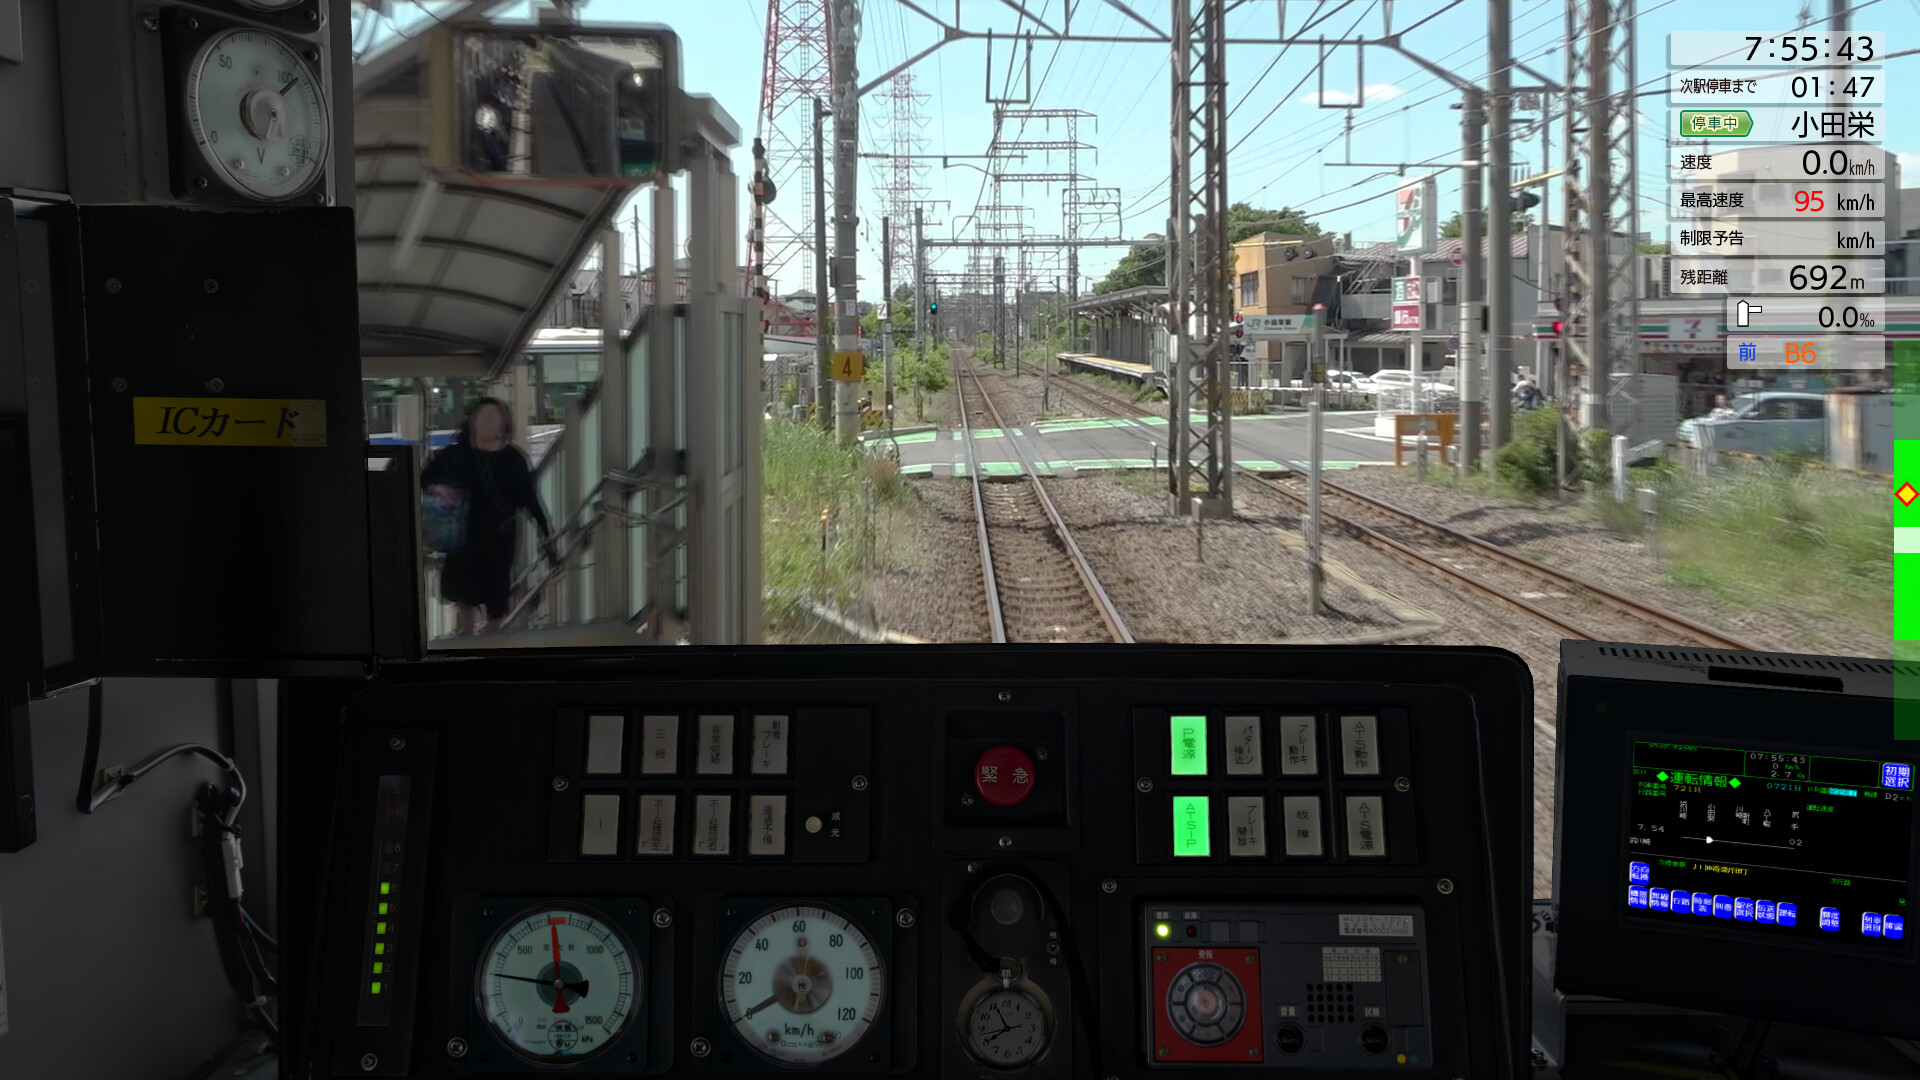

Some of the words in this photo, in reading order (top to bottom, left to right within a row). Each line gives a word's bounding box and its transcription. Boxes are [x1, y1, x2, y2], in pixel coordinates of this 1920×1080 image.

[219, 55, 232, 69] 50
[278, 70, 292, 83] 100
[211, 130, 218, 144] 0
[257, 147, 265, 164] V
[1247, 319, 1261, 327] JR
[842, 356, 852, 377] 4
[156, 406, 300, 439] ICカード
[1182, 728, 1196, 760] P電源
[1243, 725, 1254, 765] パターン
[1354, 721, 1369, 769] ATS動作
[1234, 746, 1244, 765] 接近
[1289, 745, 1299, 764] 動作
[981, 765, 1029, 784] 緊急
[1885, 765, 1911, 777] 初期
[1670, 771, 1728, 788] 運転情報
[1673, 784, 1701, 794] 721H
[1766, 782, 1802, 792] 0721H
[1296, 810, 1310, 840] 故障
[1359, 802, 1375, 850] ATS電源
[1237, 827, 1247, 847] 開放
[792, 920, 806, 933] 60
[755, 938, 769, 951] 40
[829, 934, 843, 947] 80
[517, 945, 533, 954] 500
[586, 945, 604, 954] 1000
[1198, 950, 1213, 960] 発報
[738, 971, 752, 984] 20
[845, 967, 863, 980] 100
[837, 1007, 856, 1021] 120
[1281, 1006, 1296, 1017] 音量
[584, 1015, 603, 1025] 1500
[784, 1023, 815, 1037] km/h
